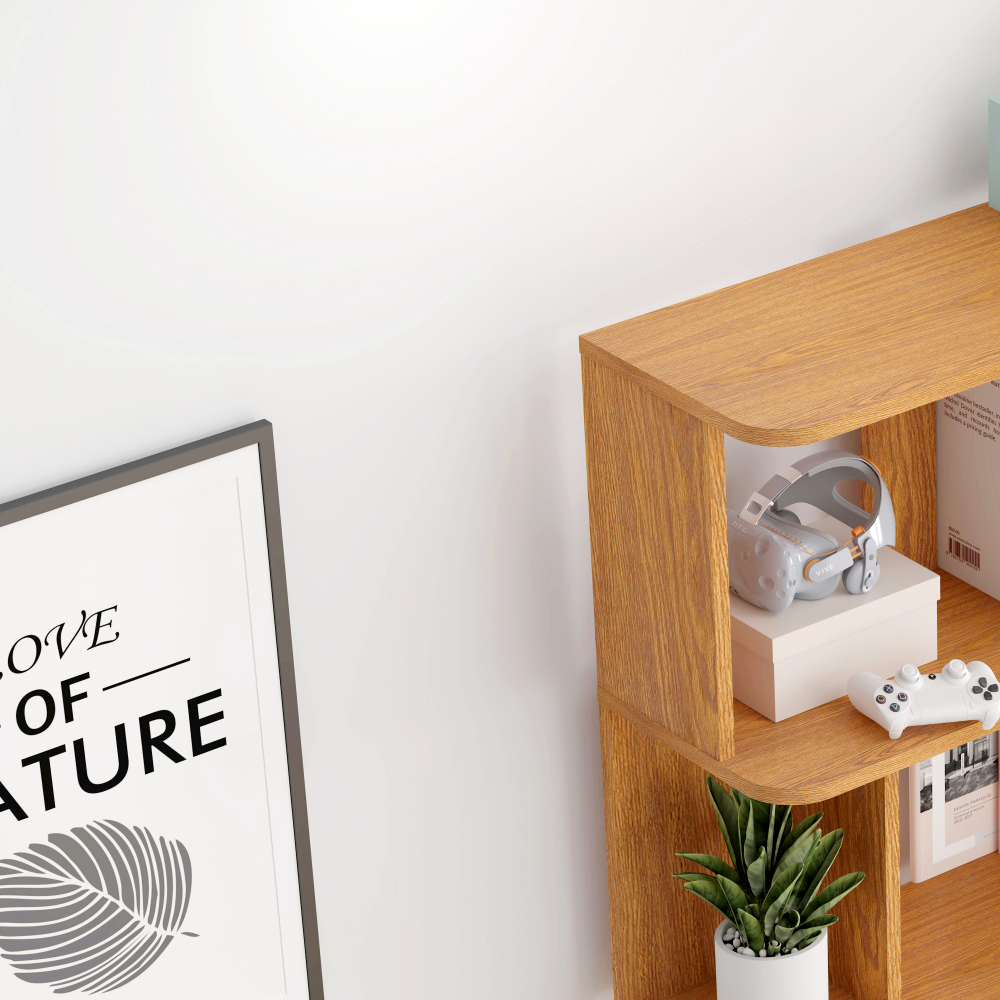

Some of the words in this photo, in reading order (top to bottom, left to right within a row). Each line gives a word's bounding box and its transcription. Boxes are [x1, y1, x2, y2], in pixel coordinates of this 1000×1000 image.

[958, 410, 968, 419] and
[815, 562, 835, 576] VIVE
[0, 605, 120, 680] OVE
[16, 671, 90, 736] OF
